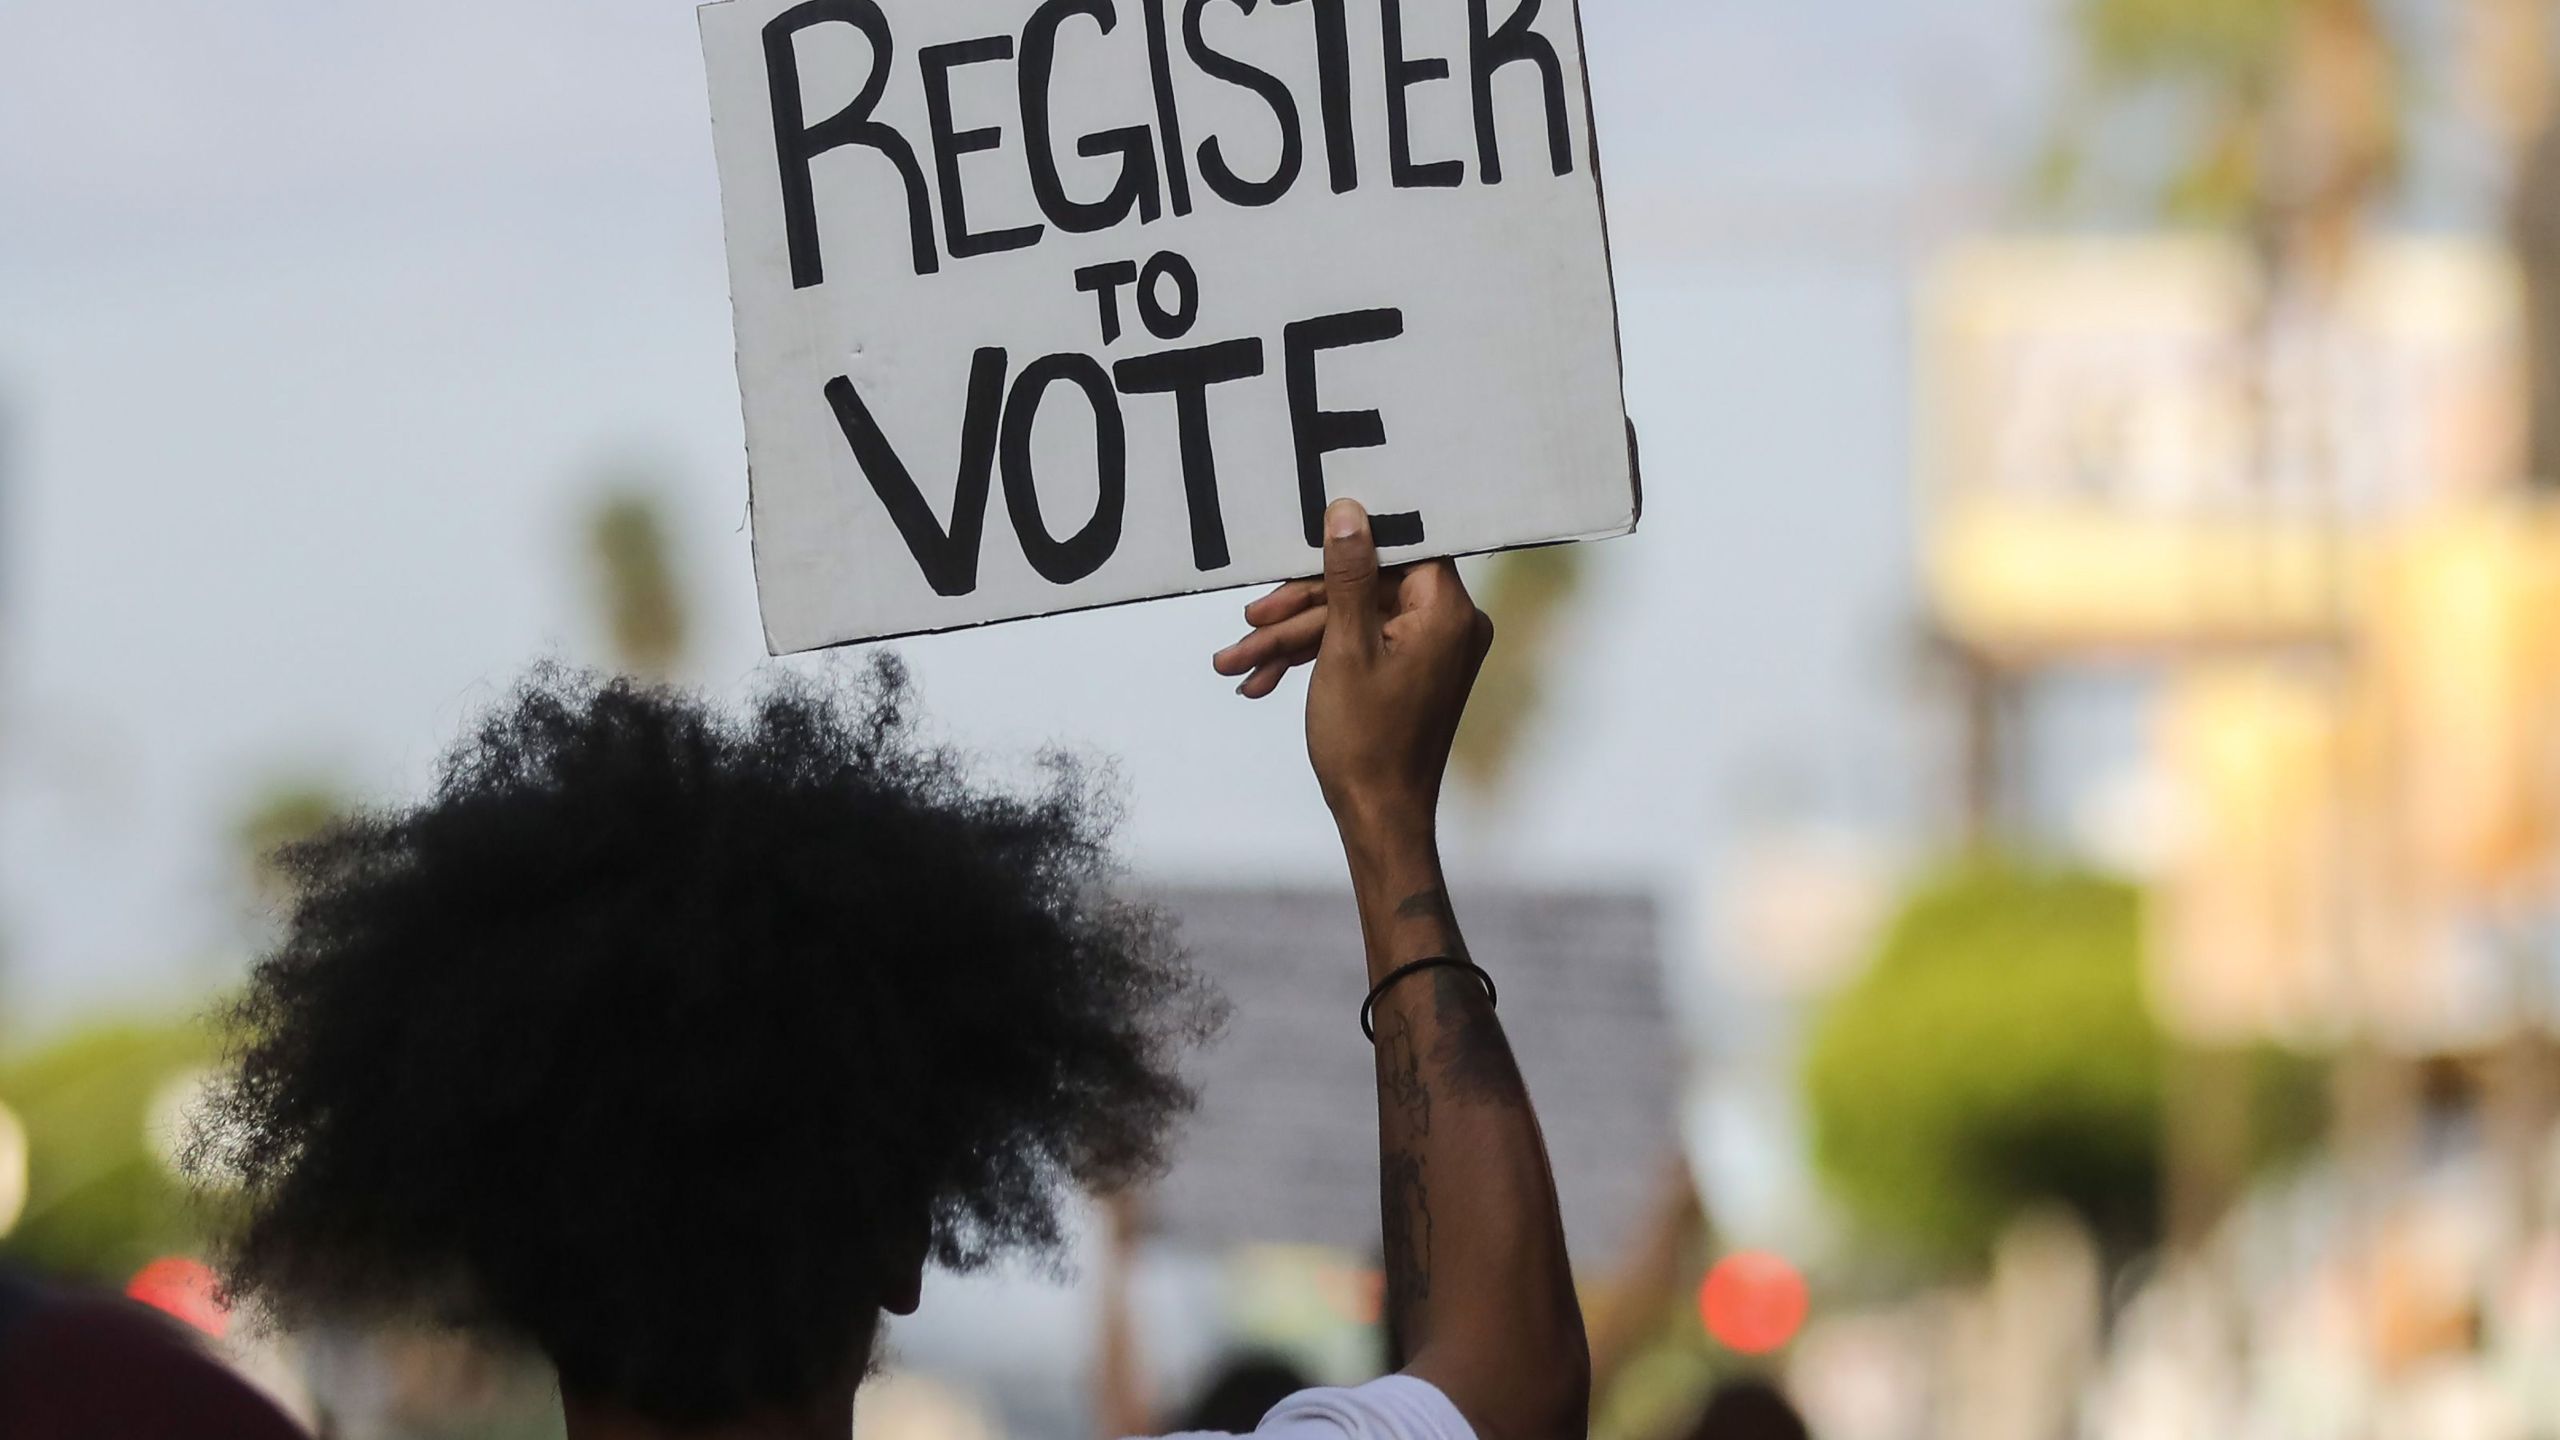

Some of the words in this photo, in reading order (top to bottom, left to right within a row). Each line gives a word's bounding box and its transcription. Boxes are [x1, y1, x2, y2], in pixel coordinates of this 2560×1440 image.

[762, 0, 1573, 289] REGISTER
[1074, 250, 1198, 345] TO
[824, 308, 1424, 596] VOTE
